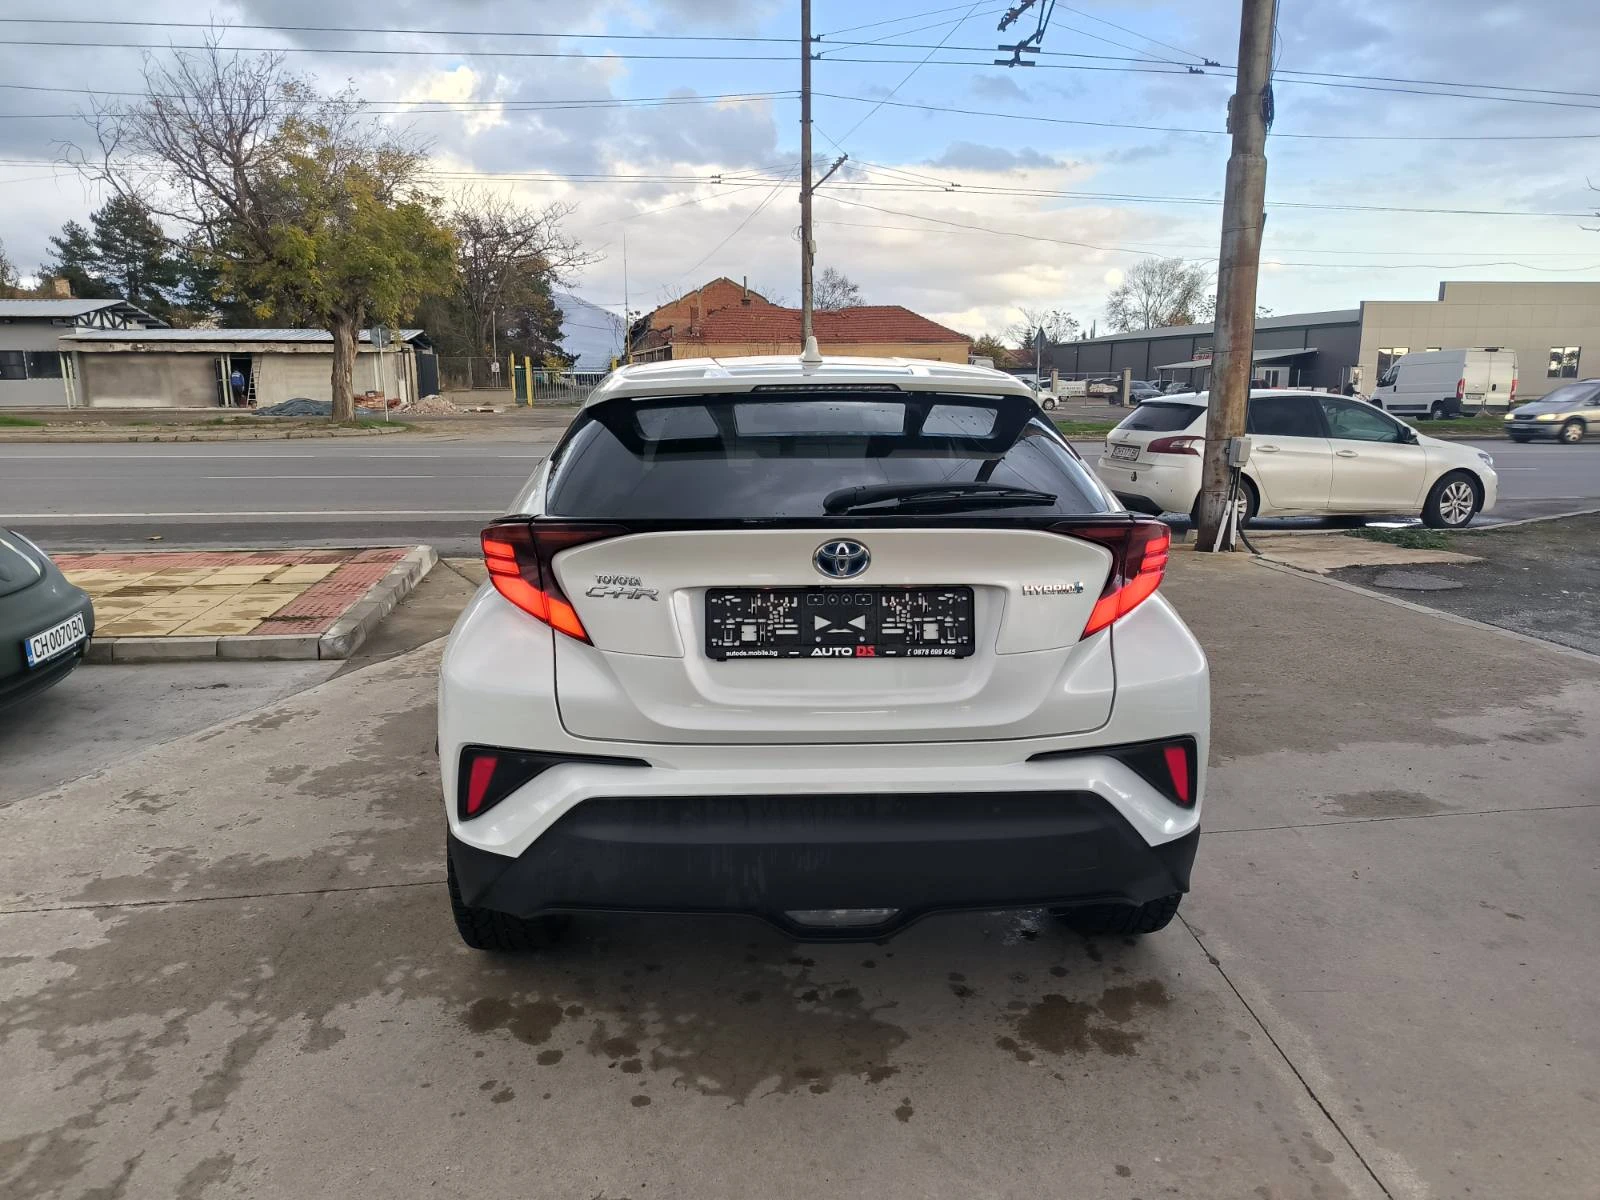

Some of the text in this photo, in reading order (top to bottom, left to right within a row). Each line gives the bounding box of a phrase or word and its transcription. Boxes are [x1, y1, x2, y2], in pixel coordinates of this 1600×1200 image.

[595, 575, 642, 586] TOYOTA
[585, 586, 659, 601] C-HR
[33, 617, 84, 659] CH0070BO
[810, 647, 853, 656] AUTO
[856, 645, 875, 656] DS
[913, 648, 930, 656] 0878
